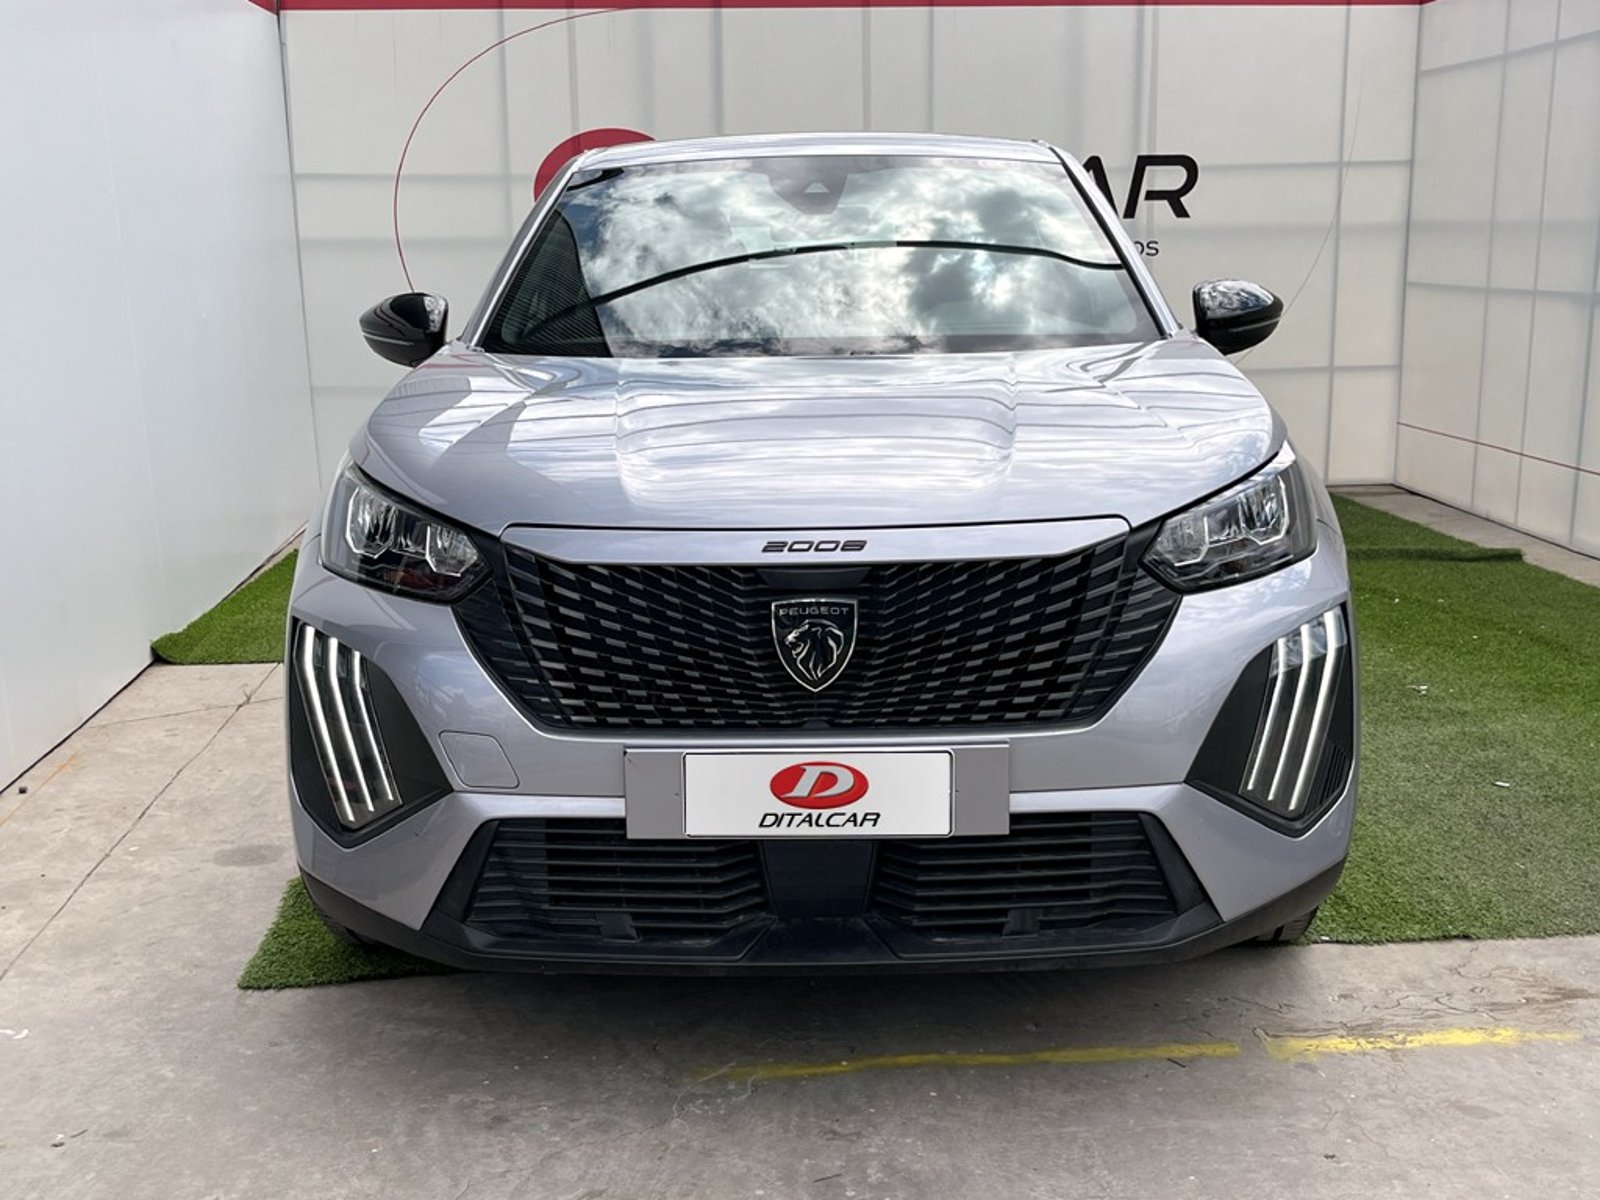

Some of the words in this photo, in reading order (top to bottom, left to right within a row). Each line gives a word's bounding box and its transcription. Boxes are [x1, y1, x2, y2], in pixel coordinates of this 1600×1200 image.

[761, 540, 867, 553] 2008
[779, 606, 849, 616] PEUGEOT
[758, 812, 881, 828] DITALCAR
